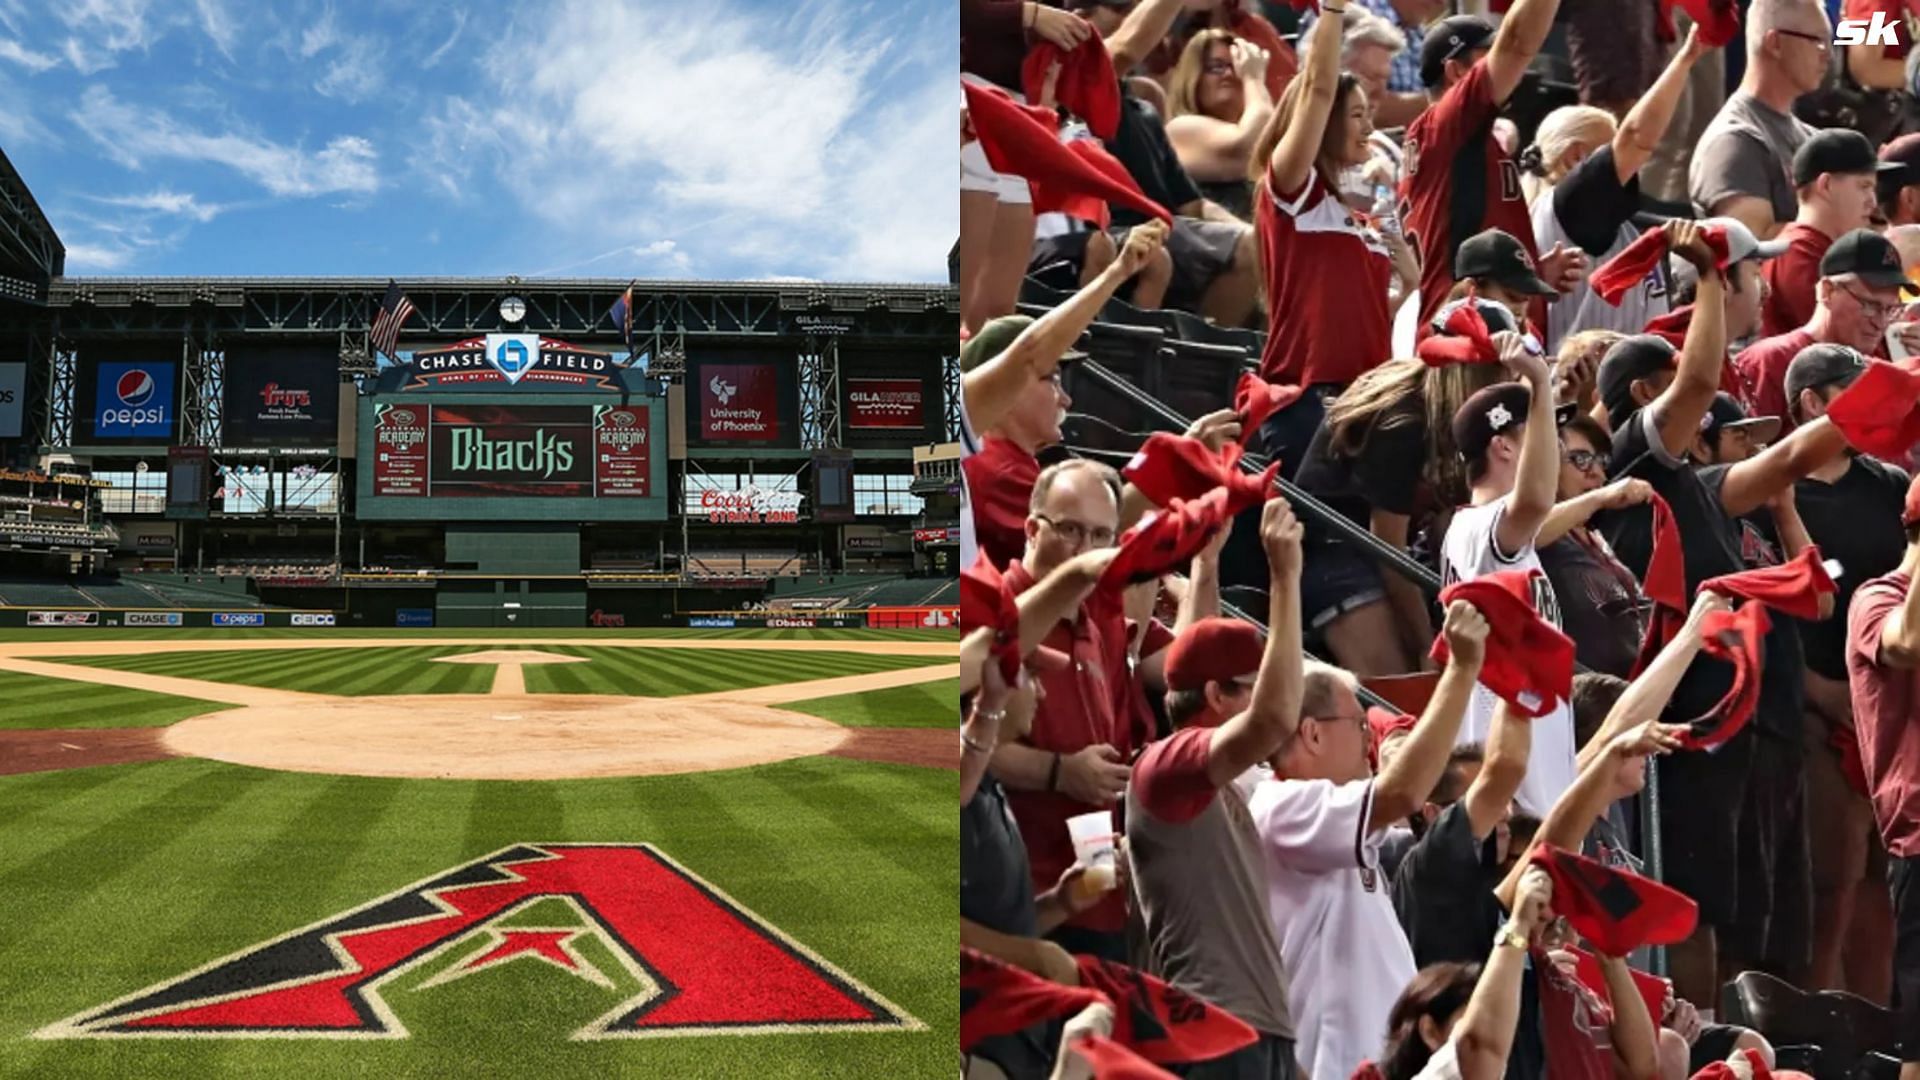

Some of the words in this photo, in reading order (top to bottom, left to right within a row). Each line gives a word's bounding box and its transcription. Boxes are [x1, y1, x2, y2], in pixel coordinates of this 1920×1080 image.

[795, 315, 821, 324] GILA
[419, 353, 482, 370] CHASE
[543, 353, 605, 371] FIELD
[850, 392, 879, 402] GILA
[879, 392, 921, 403] RIVER
[102, 405, 164, 428] pepsi
[710, 408, 761, 420] University
[711, 421, 721, 431] of
[723, 421, 765, 431] Phoenix
[600, 431, 646, 447] ACADEMY
[451, 428, 573, 479] Dbacks
[53, 475, 86, 486] SPORTS
[89, 479, 113, 488] GRILL
[701, 488, 752, 508] Coors
[709, 510, 760, 523] STRIKE
[765, 510, 798, 523] ZONE
[11, 535, 43, 543] WELCOME
[129, 614, 166, 623] CHASE
[230, 614, 257, 625] pepsi
[292, 614, 336, 625] GEICO
[766, 619, 813, 627] @Dbacks
